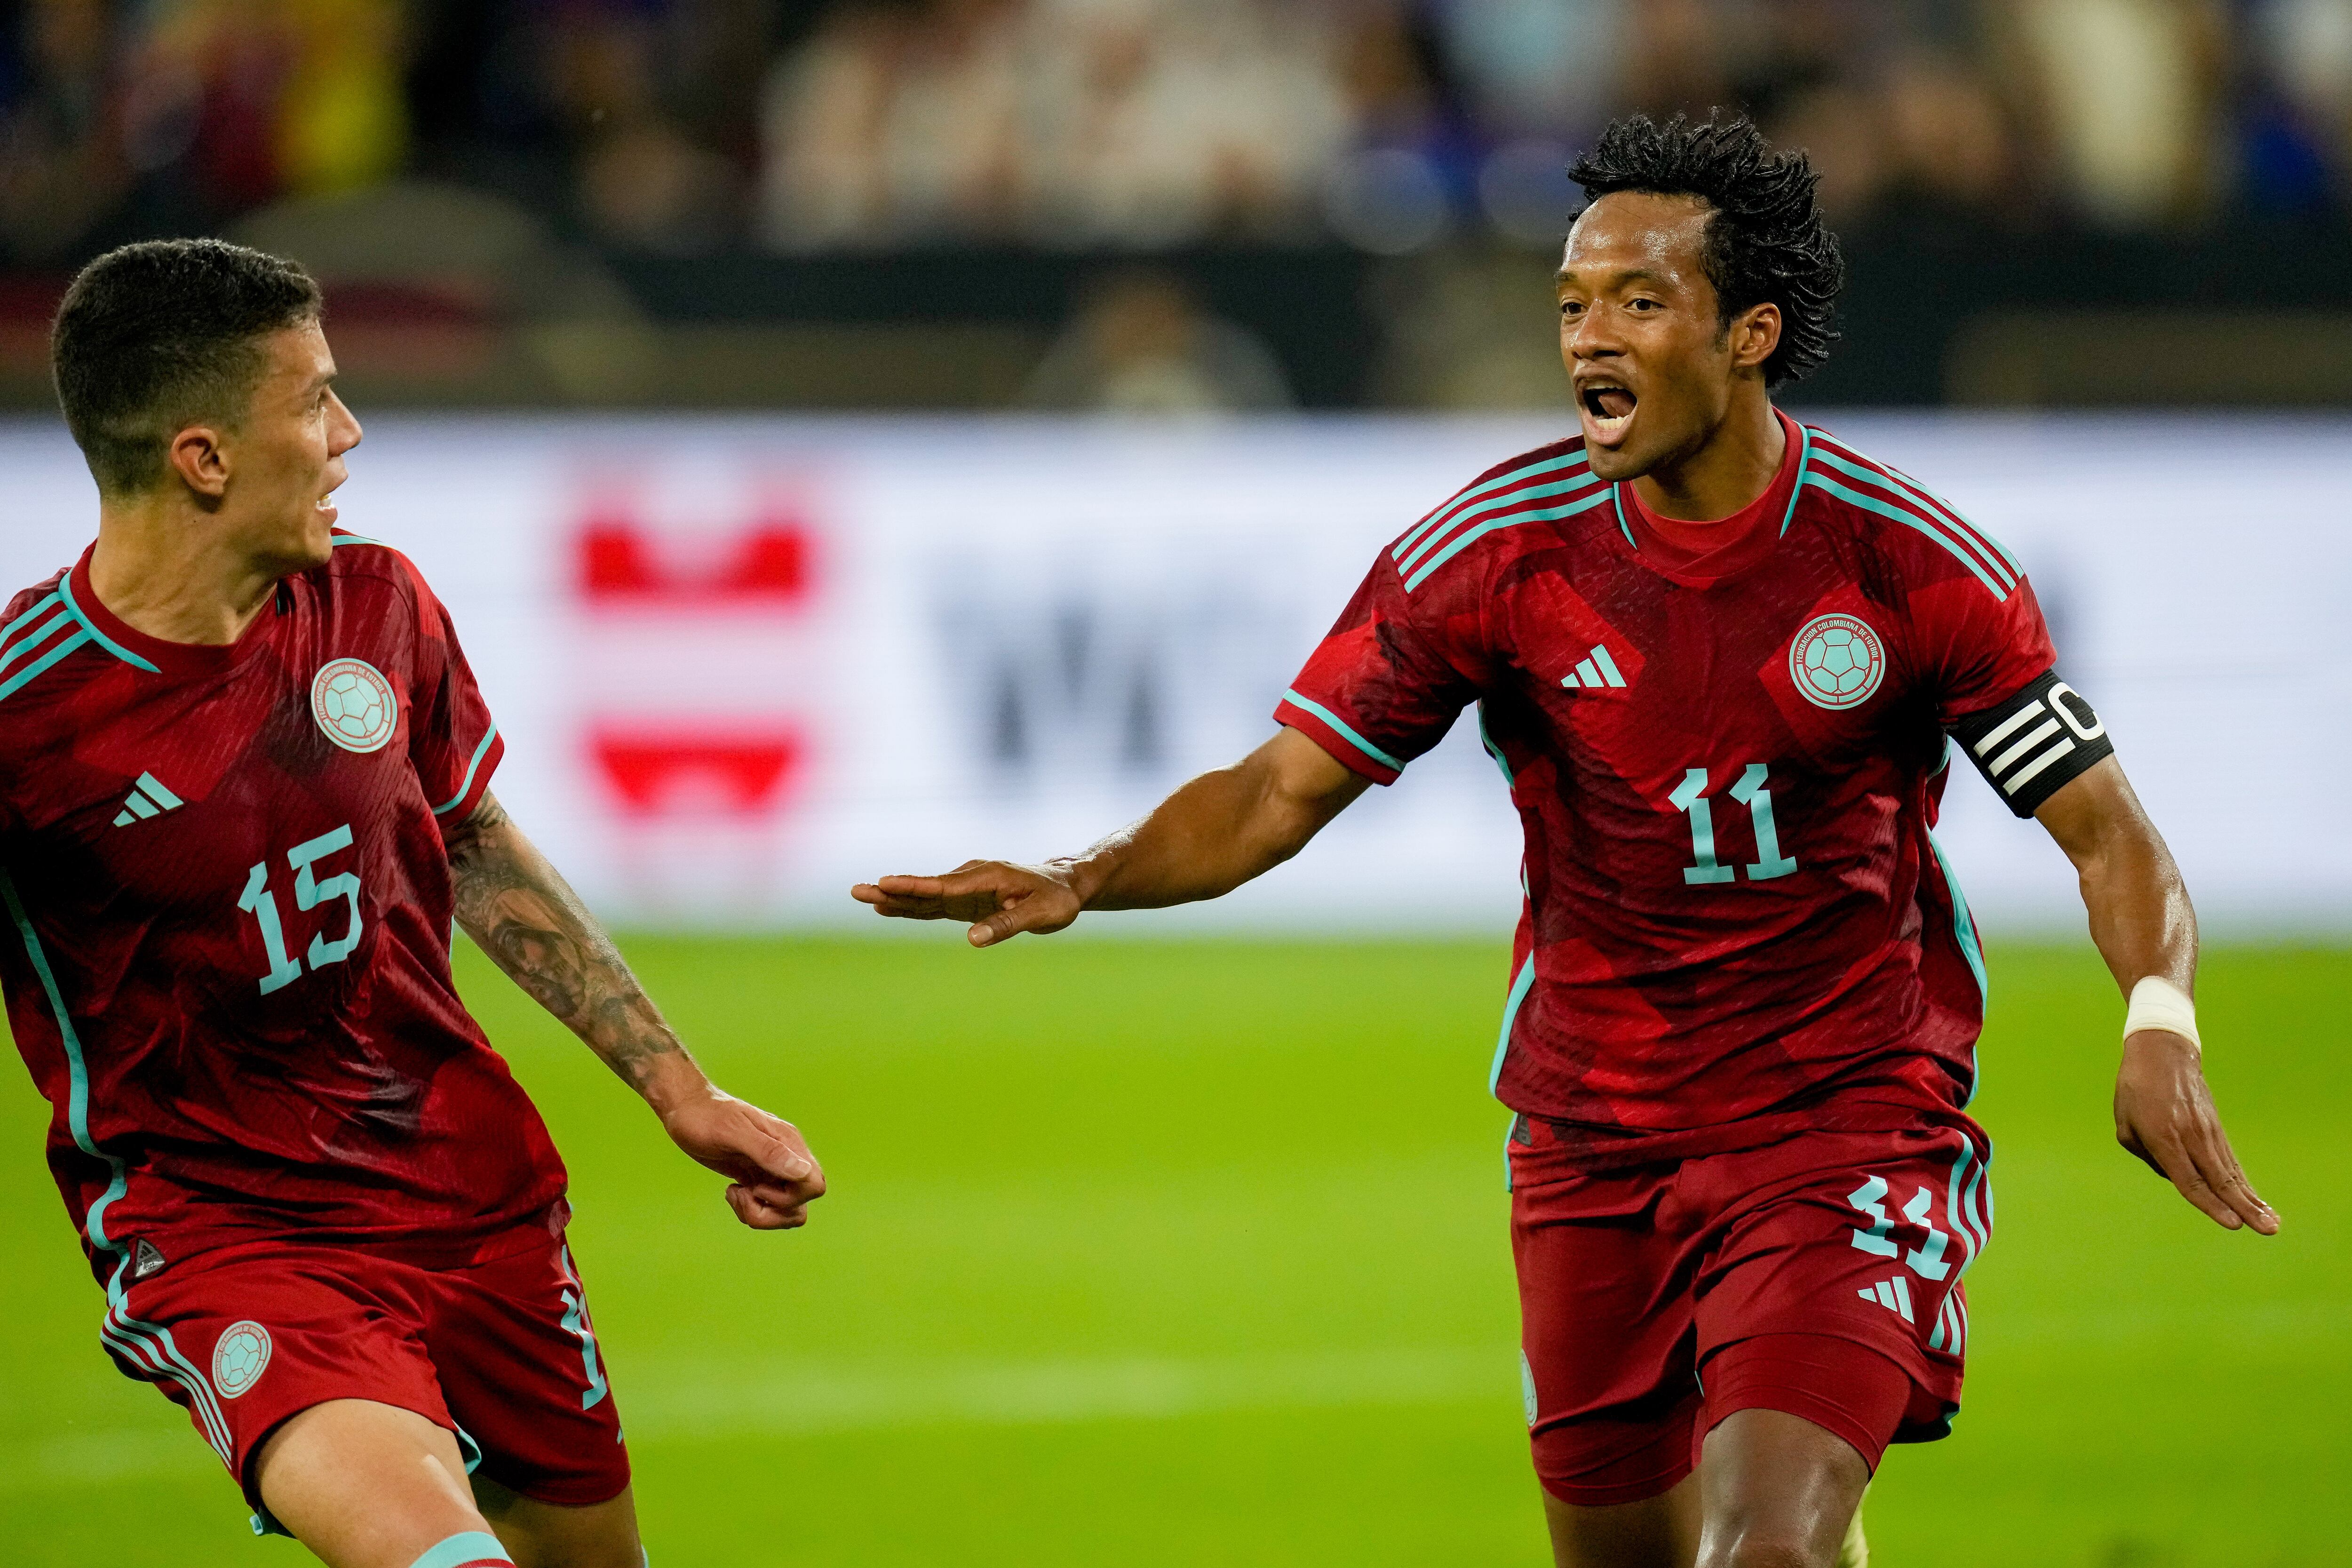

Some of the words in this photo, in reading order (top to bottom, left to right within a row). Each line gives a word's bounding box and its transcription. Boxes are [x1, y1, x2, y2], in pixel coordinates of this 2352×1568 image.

[1796, 627, 1818, 663] FEDERACION
[1817, 620, 1859, 632] COLOMBIANA
[1858, 628, 1867, 638] DE
[1864, 635, 1879, 660] FUTBOL
[1668, 763, 1797, 885] 11
[237, 823, 363, 996] 15
[1847, 1174, 1951, 1281] 11
